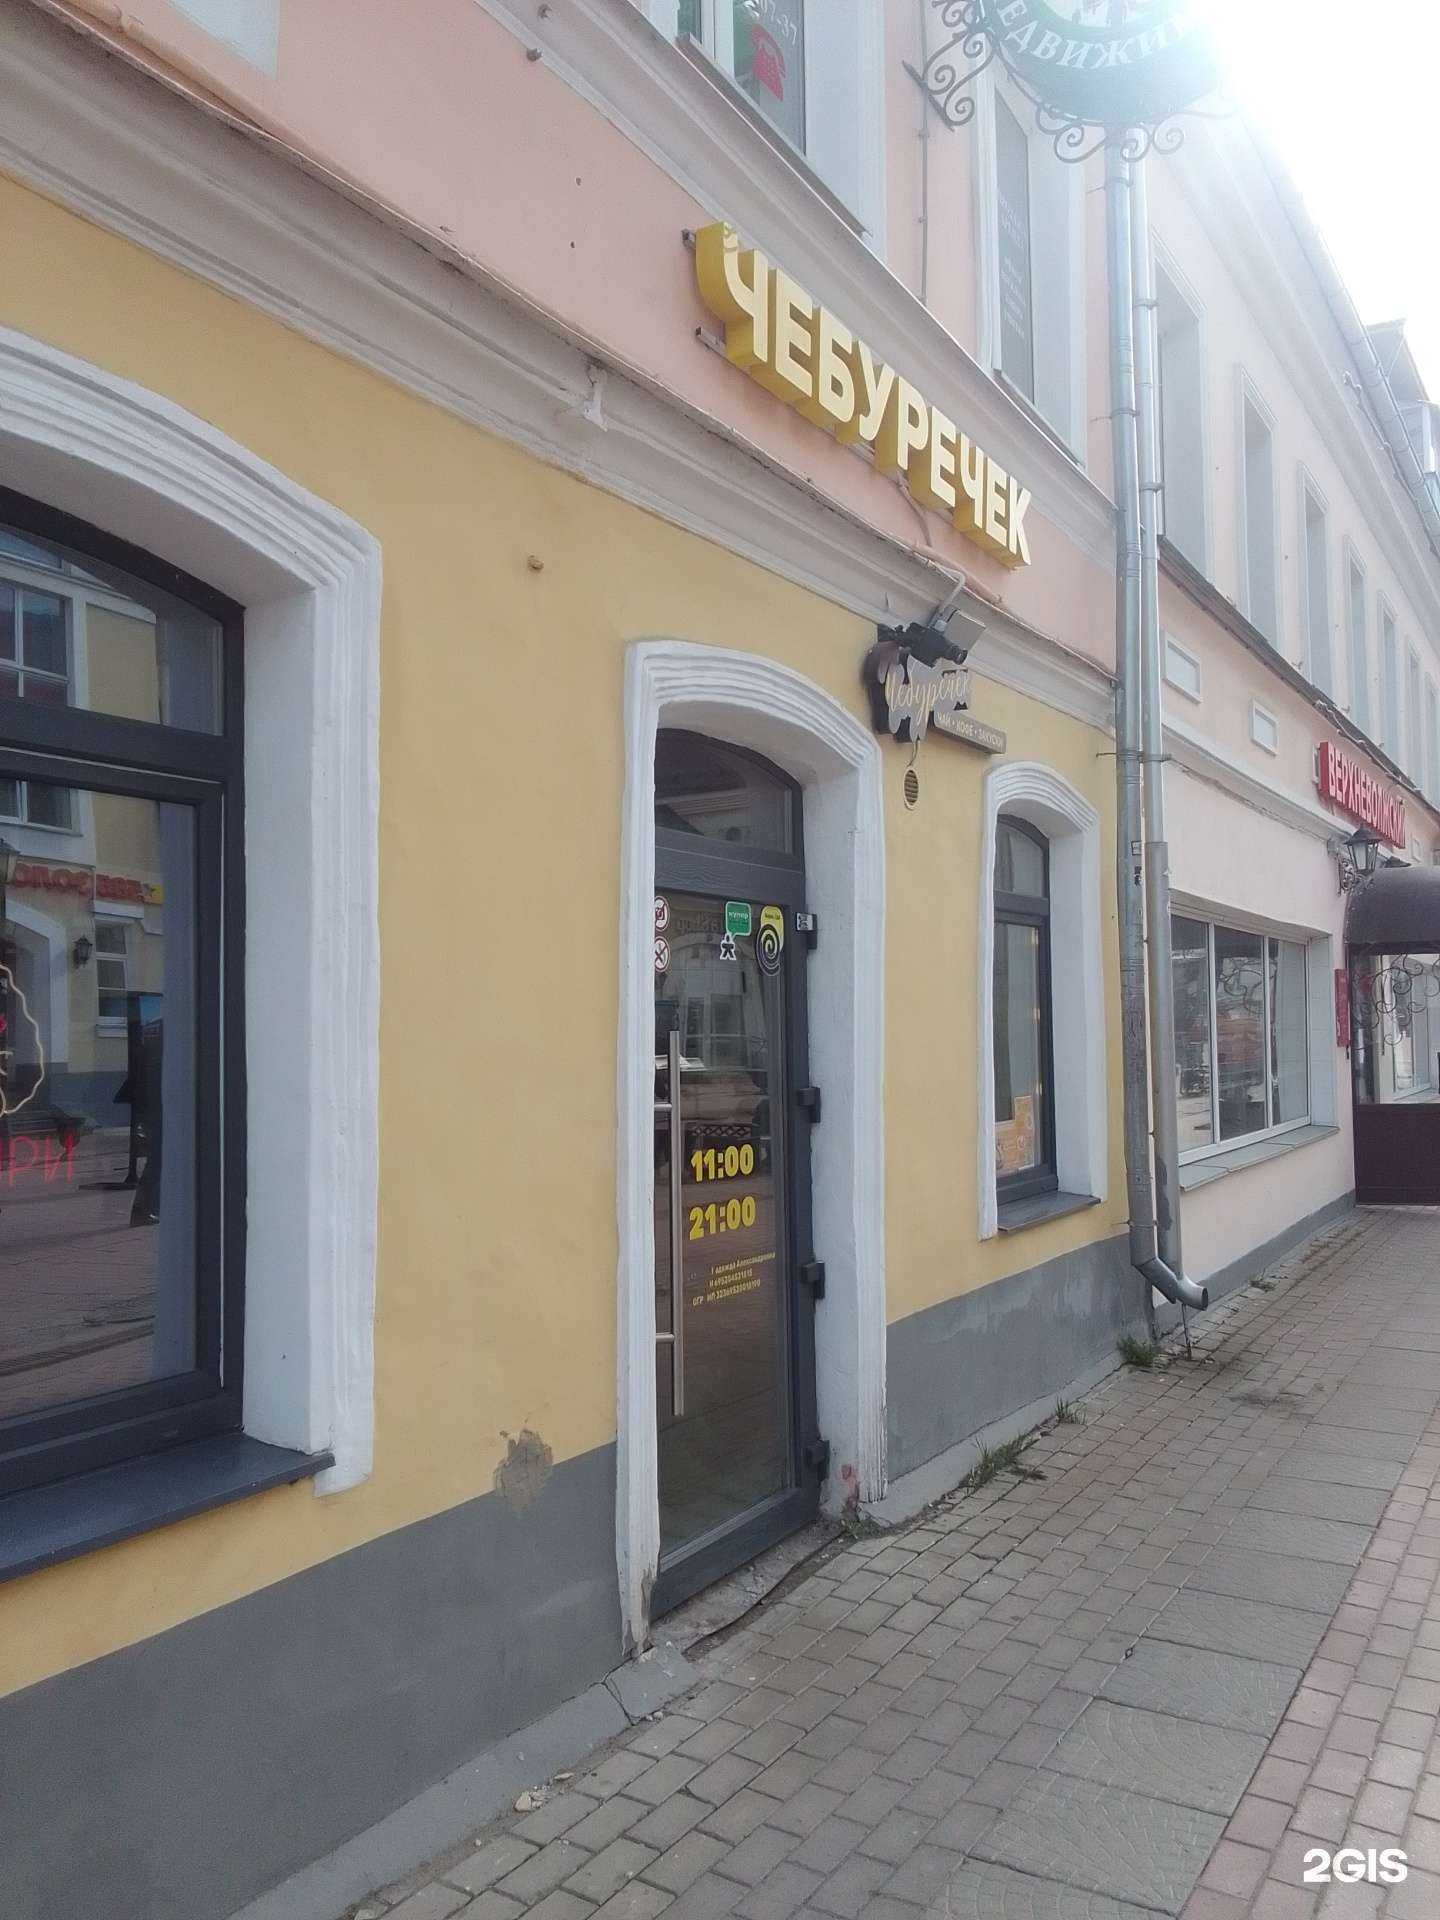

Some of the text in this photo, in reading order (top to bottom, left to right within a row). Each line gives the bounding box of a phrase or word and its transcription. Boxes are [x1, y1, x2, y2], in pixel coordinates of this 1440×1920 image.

[722, 222, 1032, 566] ЧЕБУРЕЧЕК
[690, 1143, 754, 1182] 11:00
[689, 1195, 756, 1241] 21:00
